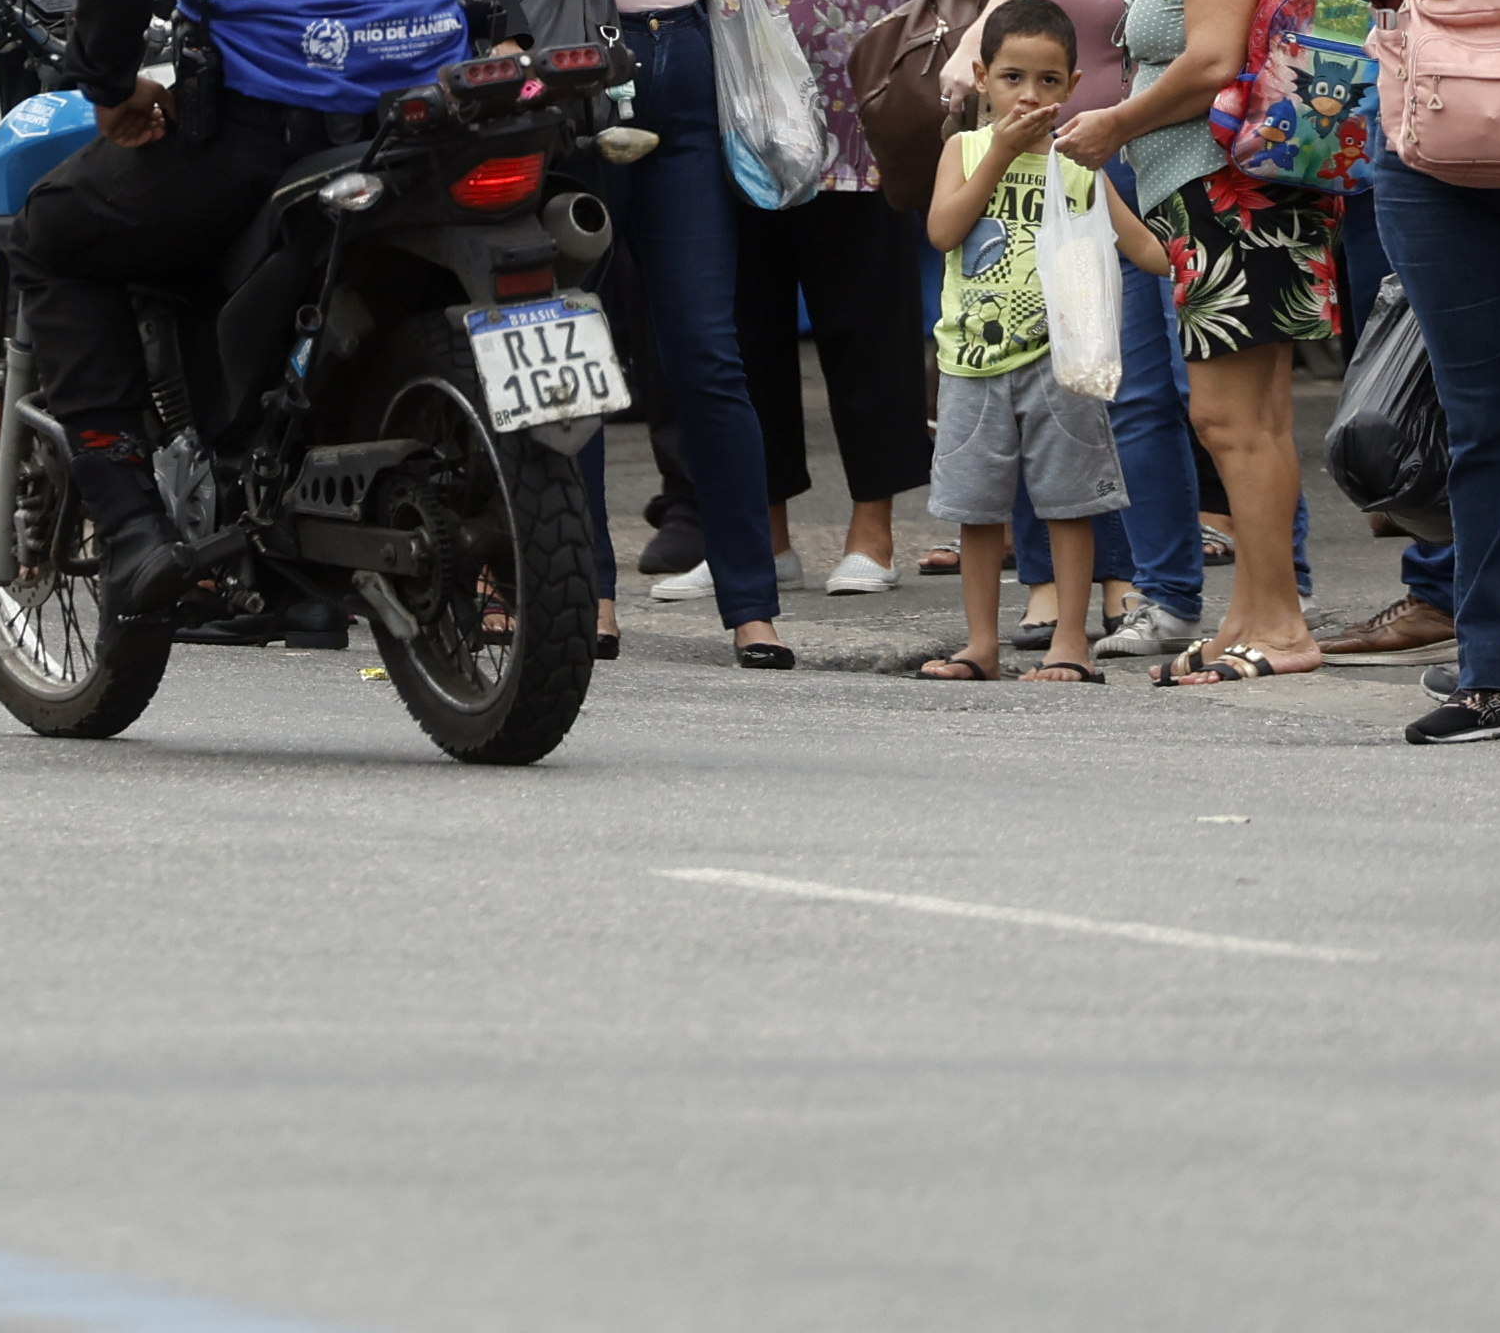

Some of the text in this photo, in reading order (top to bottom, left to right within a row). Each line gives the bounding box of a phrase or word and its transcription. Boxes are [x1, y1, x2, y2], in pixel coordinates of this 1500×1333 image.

[353, 29, 384, 44] RIO
[386, 26, 407, 41] DE
[1000, 172, 1046, 187] OLLEG
[980, 185, 1077, 223] EAG
[509, 308, 560, 326] BRASIL
[503, 321, 586, 370] RIZ
[495, 408, 512, 427] BR
